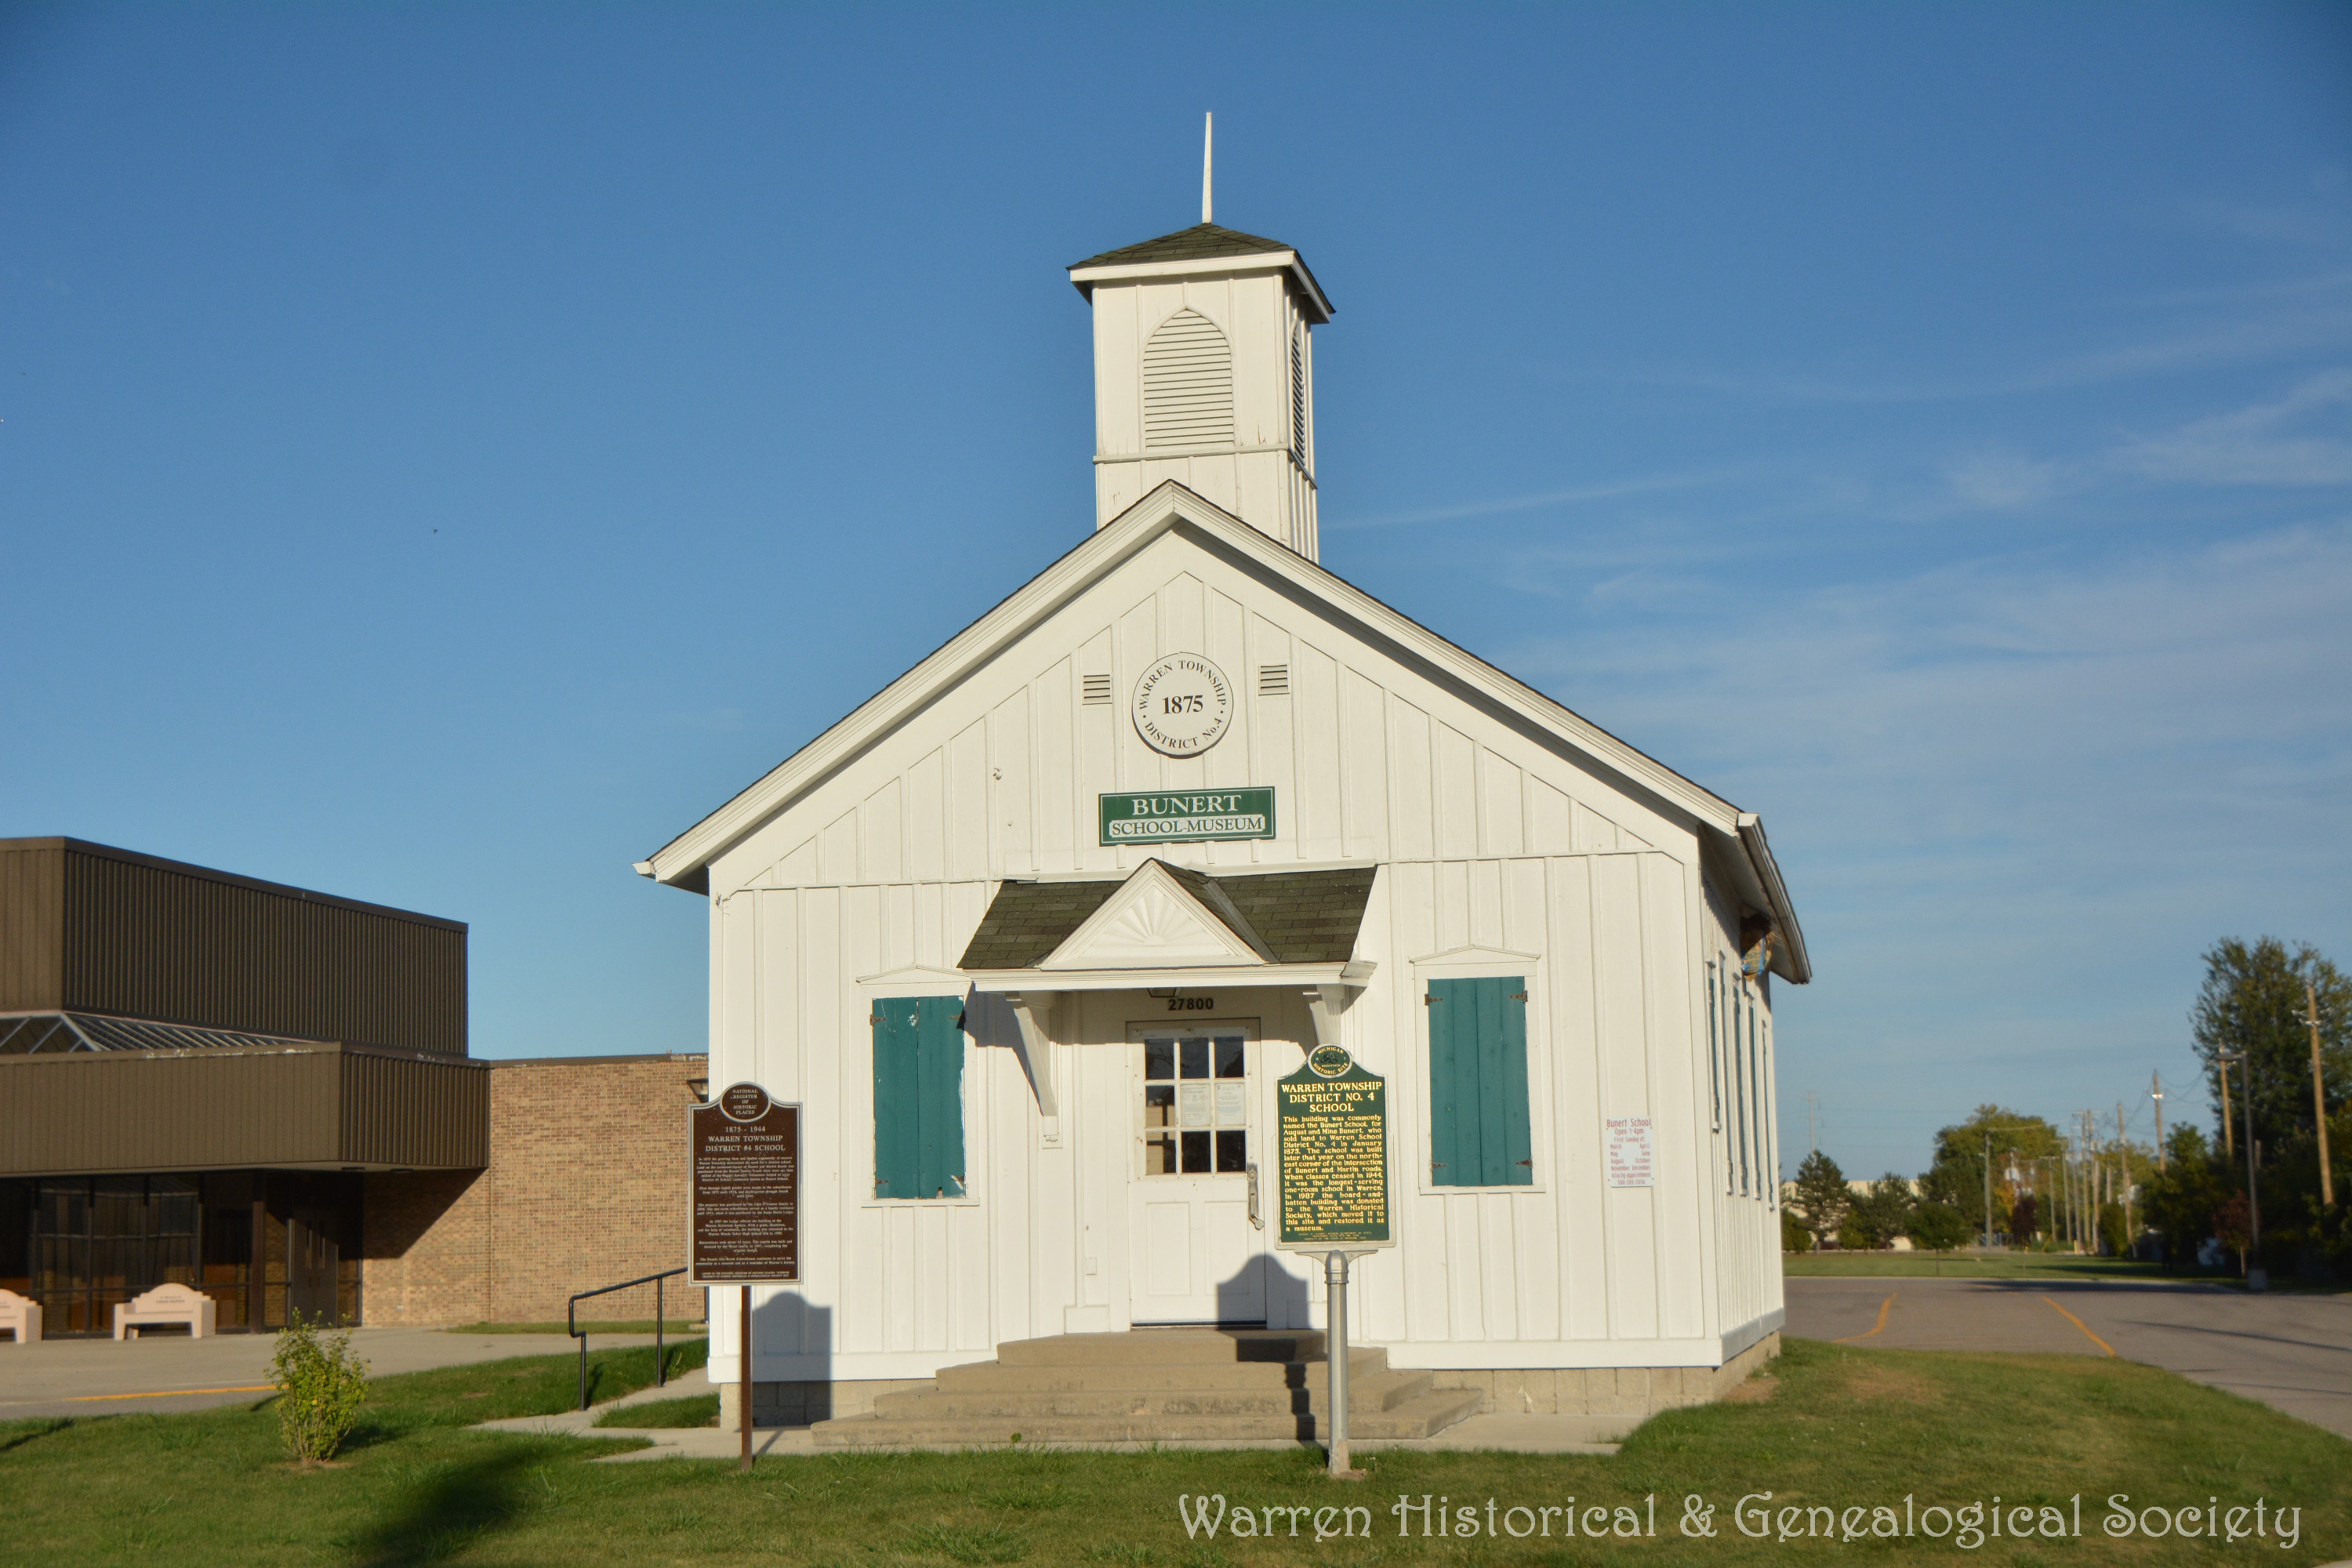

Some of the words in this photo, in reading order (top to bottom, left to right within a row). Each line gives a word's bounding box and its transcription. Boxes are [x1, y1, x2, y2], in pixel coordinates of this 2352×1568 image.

[1140, 663, 1172, 709] WARREN
[1178, 660, 1226, 705] TOWNSHIP
[1162, 695, 1203, 714] 1875
[1145, 722, 1197, 748] DISTRICT
[1132, 795, 1241, 815] BUNERT
[1112, 820, 1183, 835] SCHOOL
[1187, 817, 1262, 832] MUSEUM
[1168, 998, 1213, 1010] 27800
[1314, 1063, 1336, 1074] HISTORIC
[1338, 1062, 1348, 1072] SITE
[1281, 1083, 1324, 1093] WARREN
[1328, 1082, 1382, 1091] TOWNSHIP
[1290, 1093, 1340, 1103] DISTRICT
[1346, 1093, 1363, 1101] NO.
[1368, 1092, 1374, 1101] 4
[1310, 1103, 1354, 1112] SCHOOL
[1631, 1118, 1651, 1127] School
